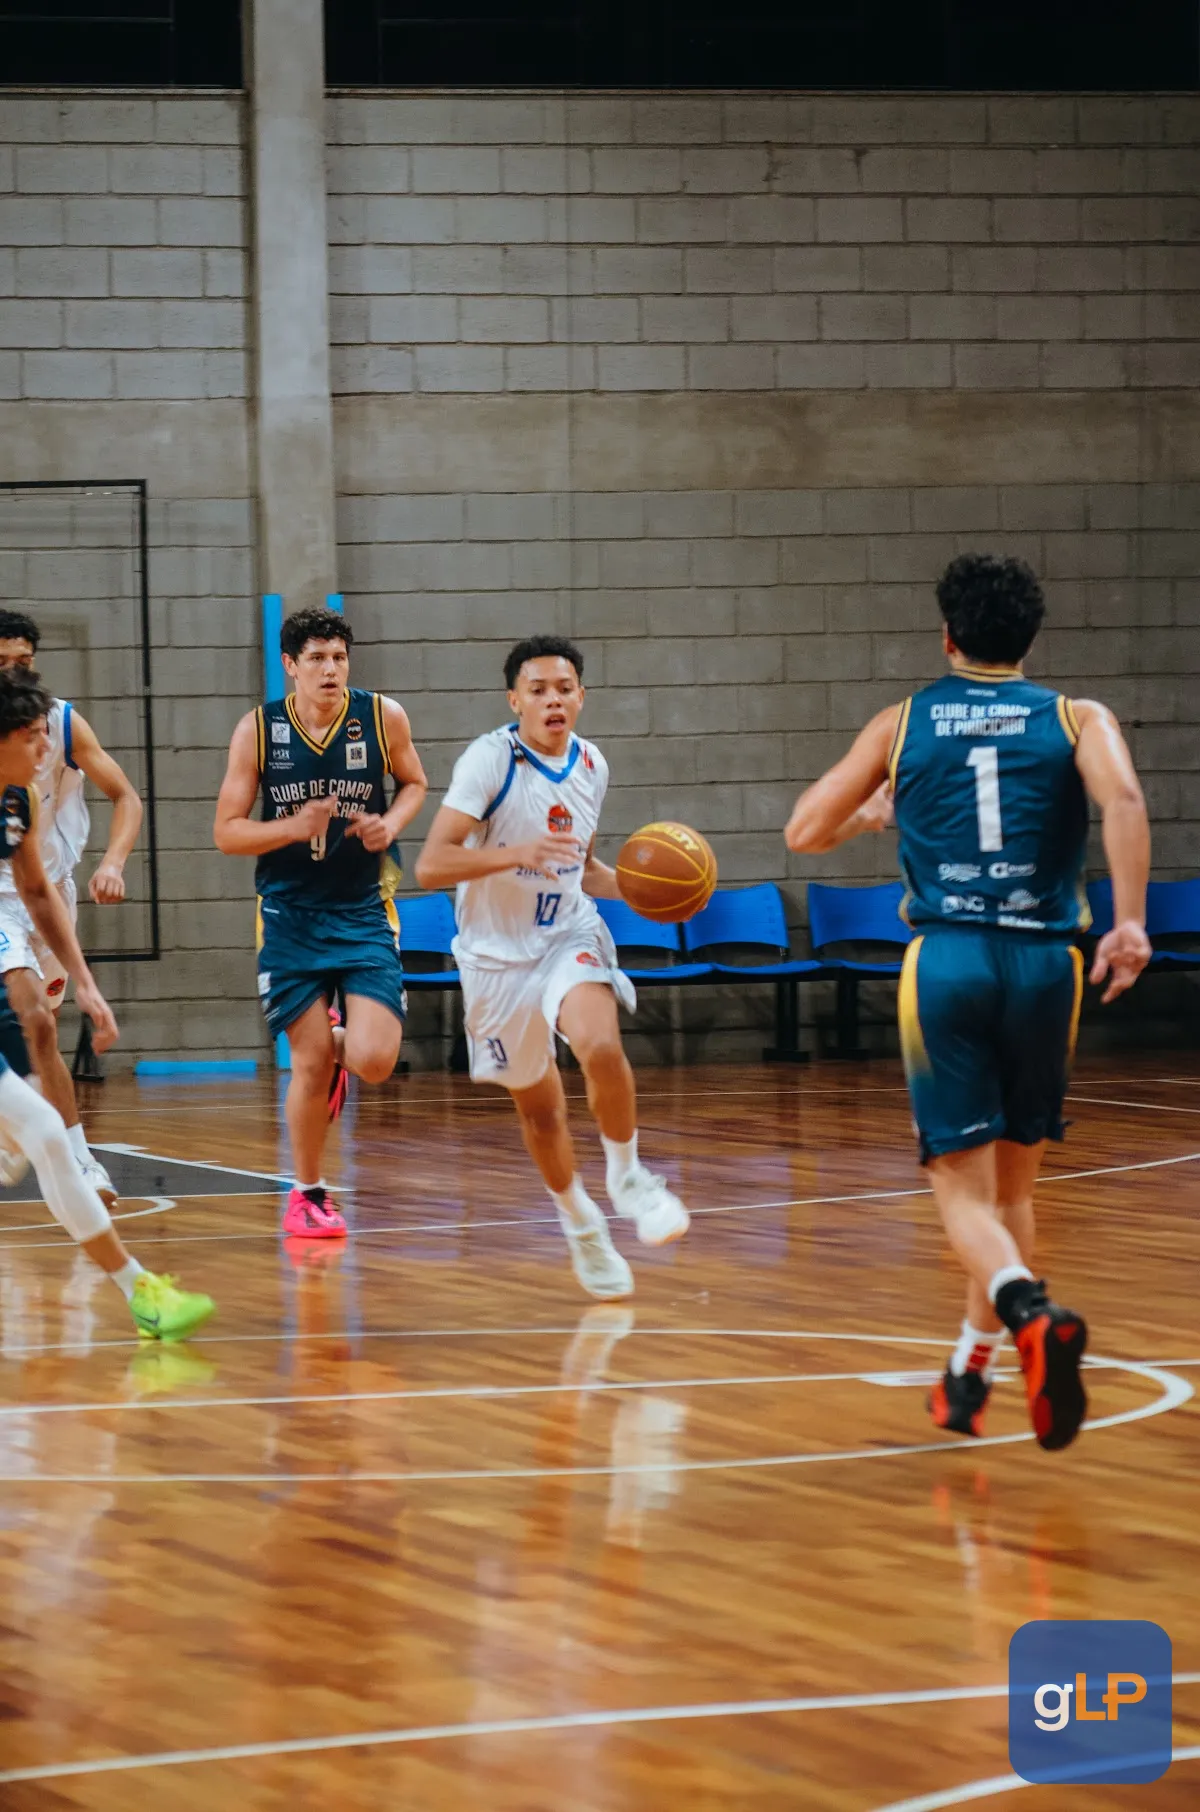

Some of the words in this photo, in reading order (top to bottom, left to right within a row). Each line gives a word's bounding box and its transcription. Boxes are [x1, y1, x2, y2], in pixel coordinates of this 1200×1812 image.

[930, 703, 969, 720] CLUBE
[970, 704, 986, 719] DE
[987, 703, 1031, 718] CAMPO
[935, 719, 953, 737] DE
[269, 781, 307, 803] CLUBE
[309, 778, 326, 798] DE
[328, 778, 373, 801] CAMPO
[965, 746, 1003, 852] 1
[534, 892, 562, 926] 10
